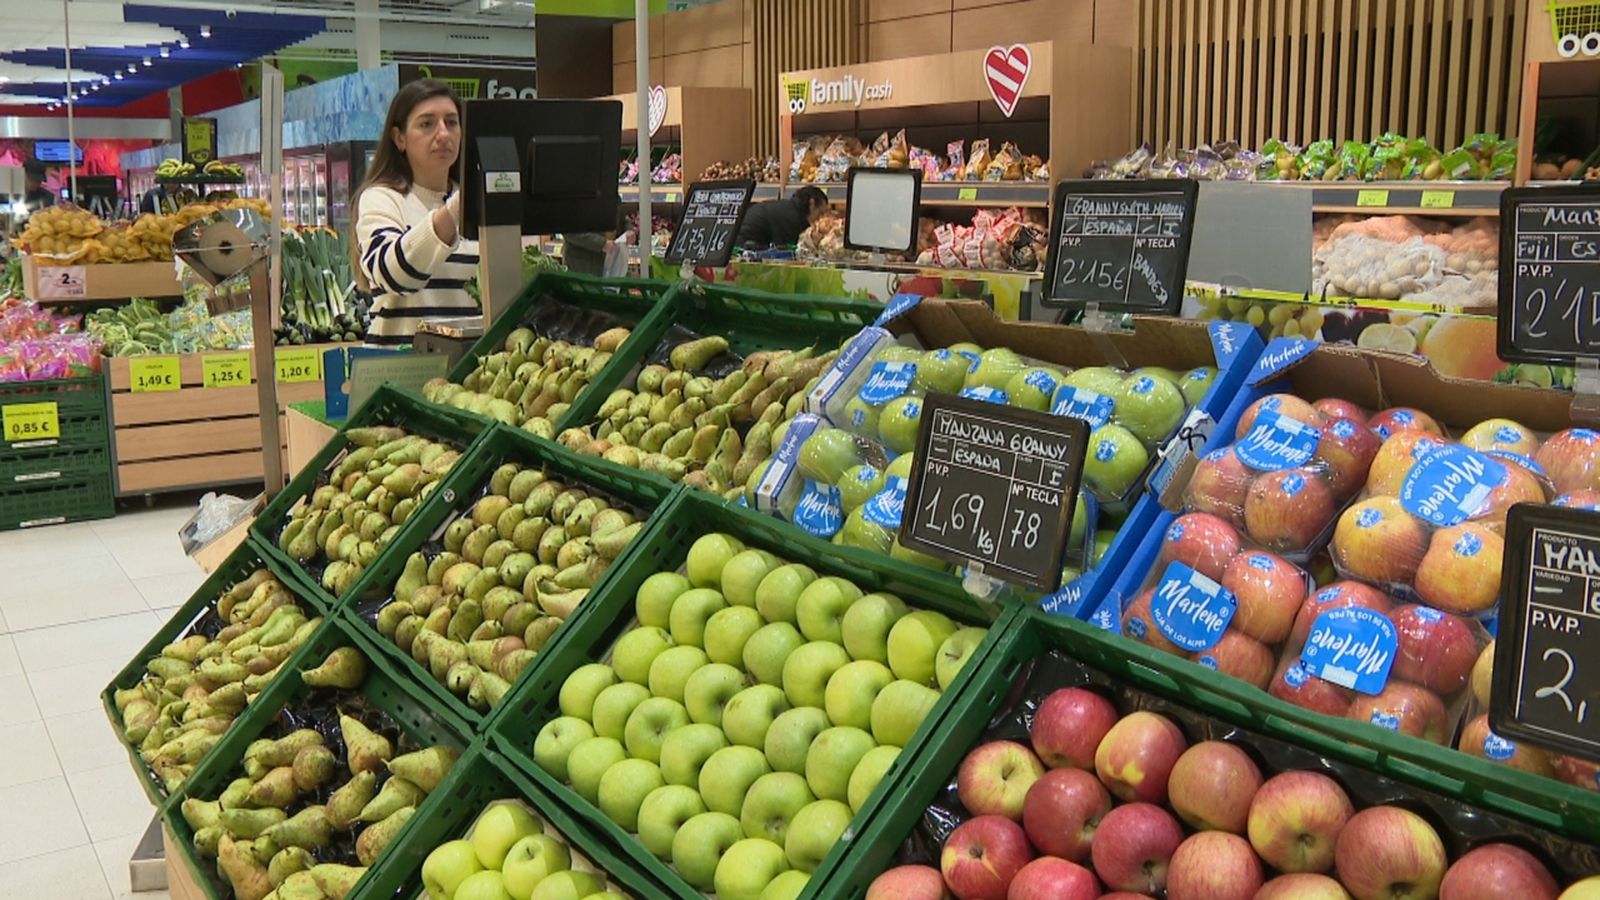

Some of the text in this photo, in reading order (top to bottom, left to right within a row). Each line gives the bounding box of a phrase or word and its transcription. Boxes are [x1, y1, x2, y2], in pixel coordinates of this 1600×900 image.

[811, 75, 893, 106] family cash
[1084, 220, 1133, 235] ESPAÑA
[710, 230, 728, 251] 16
[1062, 239, 1082, 247] P.V.P.
[1148, 239, 1175, 248] TECLA
[1518, 264, 1553, 277] P.V.P.
[211, 370, 243, 382] 1,25 €
[281, 366, 311, 378] 1,20 €
[138, 375, 172, 387] 1,49 €
[12, 422, 49, 434] 0,85 €
[940, 416, 1067, 461] MANZANA GRANNY
[1248, 423, 1312, 463] Marlene
[928, 463, 950, 478] P.V.P.
[1012, 481, 1059, 507] Nº TECLA
[1417, 454, 1485, 517] Marlene
[925, 486, 985, 536] 1,69
[977, 527, 995, 555] Kg
[1010, 508, 1042, 550] 78
[1537, 533, 1578, 545] PRODUCTO
[1534, 570, 1571, 583] VARIEDAD
[1159, 579, 1223, 633] Marlene
[1357, 611, 1372, 622] LOS
[1531, 610, 1581, 635] P.V.P.
[1164, 624, 1174, 635] DE
[1173, 633, 1187, 643] LOS
[1312, 627, 1388, 675] Marlene
